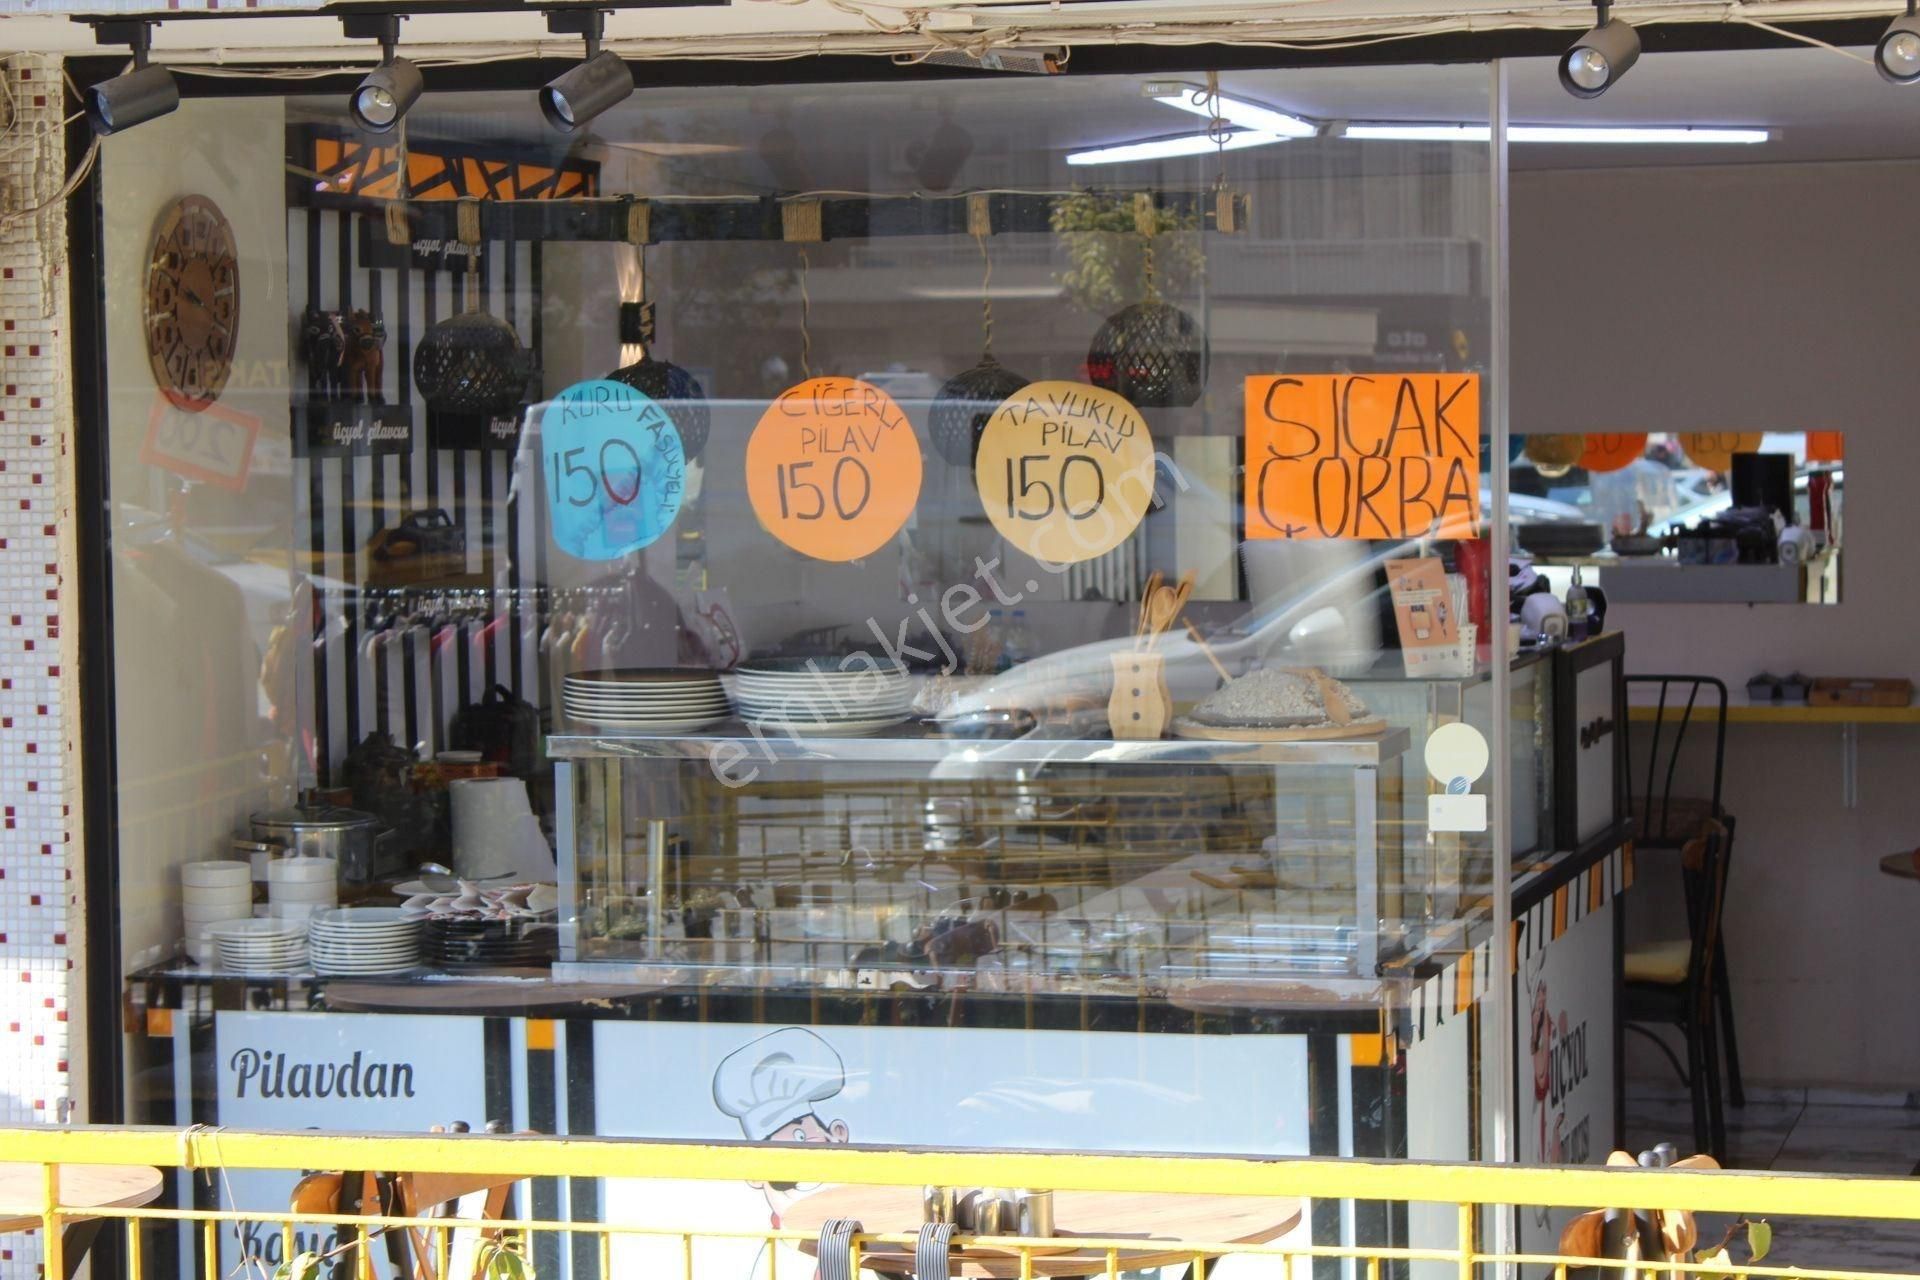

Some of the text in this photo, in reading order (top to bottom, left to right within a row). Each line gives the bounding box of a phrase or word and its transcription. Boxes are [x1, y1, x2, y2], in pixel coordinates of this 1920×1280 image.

[561, 385, 632, 425] KURU
[999, 390, 1136, 439] TAVUKLU
[1263, 376, 1475, 459] SICAK
[801, 423, 882, 455] PİLAV
[1041, 420, 1123, 454] PİLAV
[554, 438, 642, 508] 150
[776, 456, 871, 521] 150
[1006, 454, 1105, 521] 150
[1257, 455, 1479, 539] ÇORBA
[230, 1047, 416, 1099] Pilavdan
